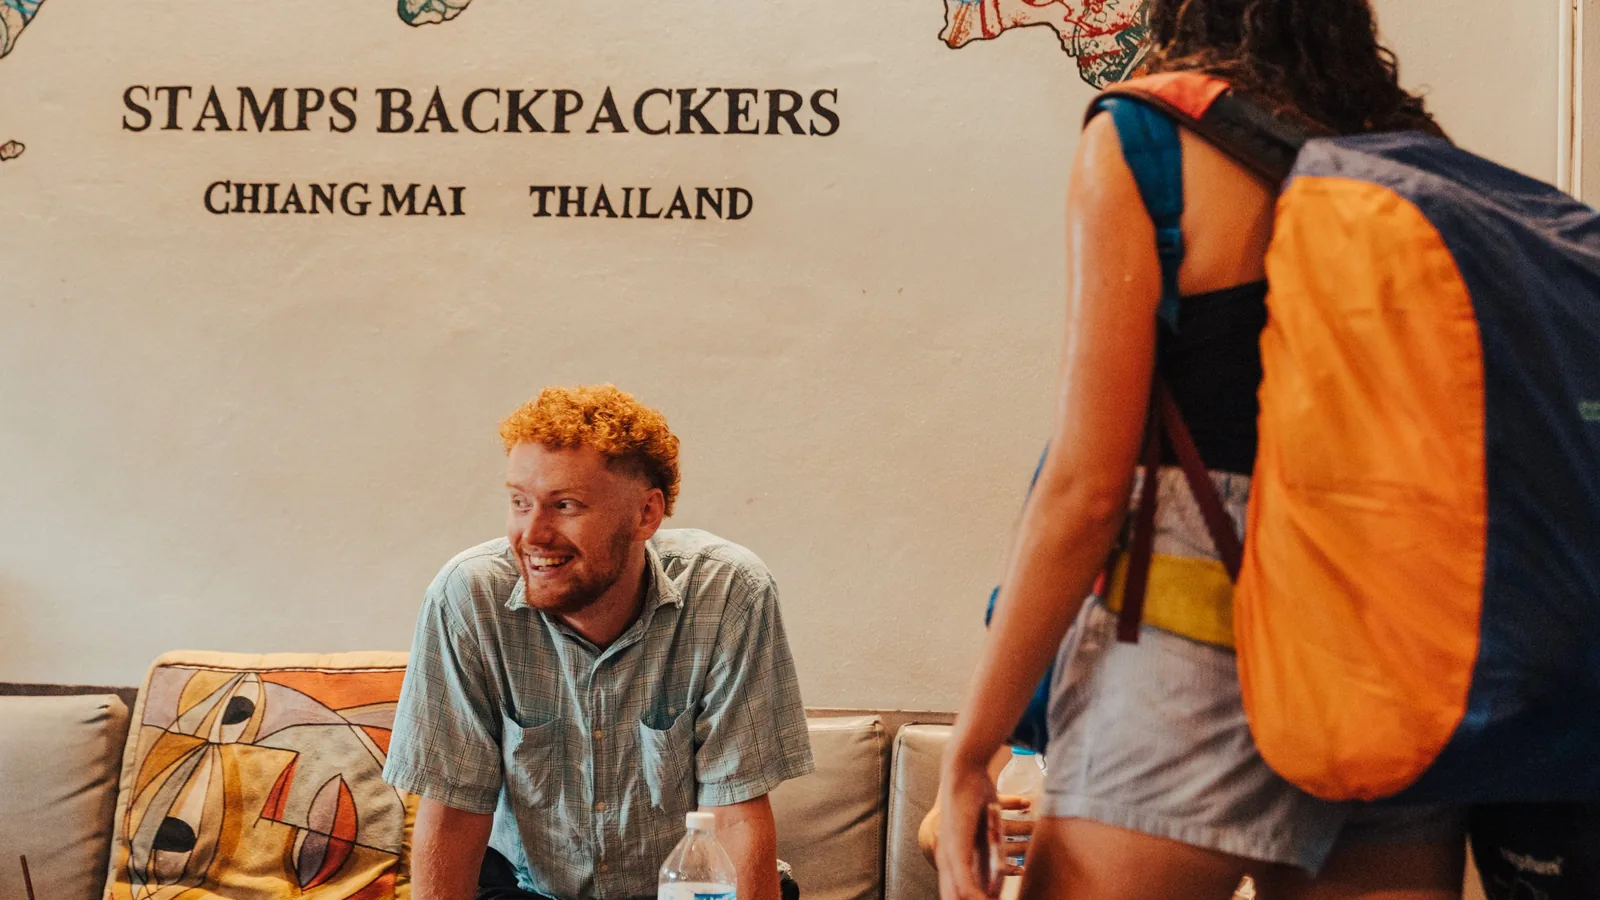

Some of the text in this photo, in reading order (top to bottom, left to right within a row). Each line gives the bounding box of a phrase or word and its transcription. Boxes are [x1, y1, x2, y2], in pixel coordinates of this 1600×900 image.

[122, 85, 840, 136] STAMPS BACKPACKERS
[204, 180, 754, 220] CHIANG MAI THAILAND
